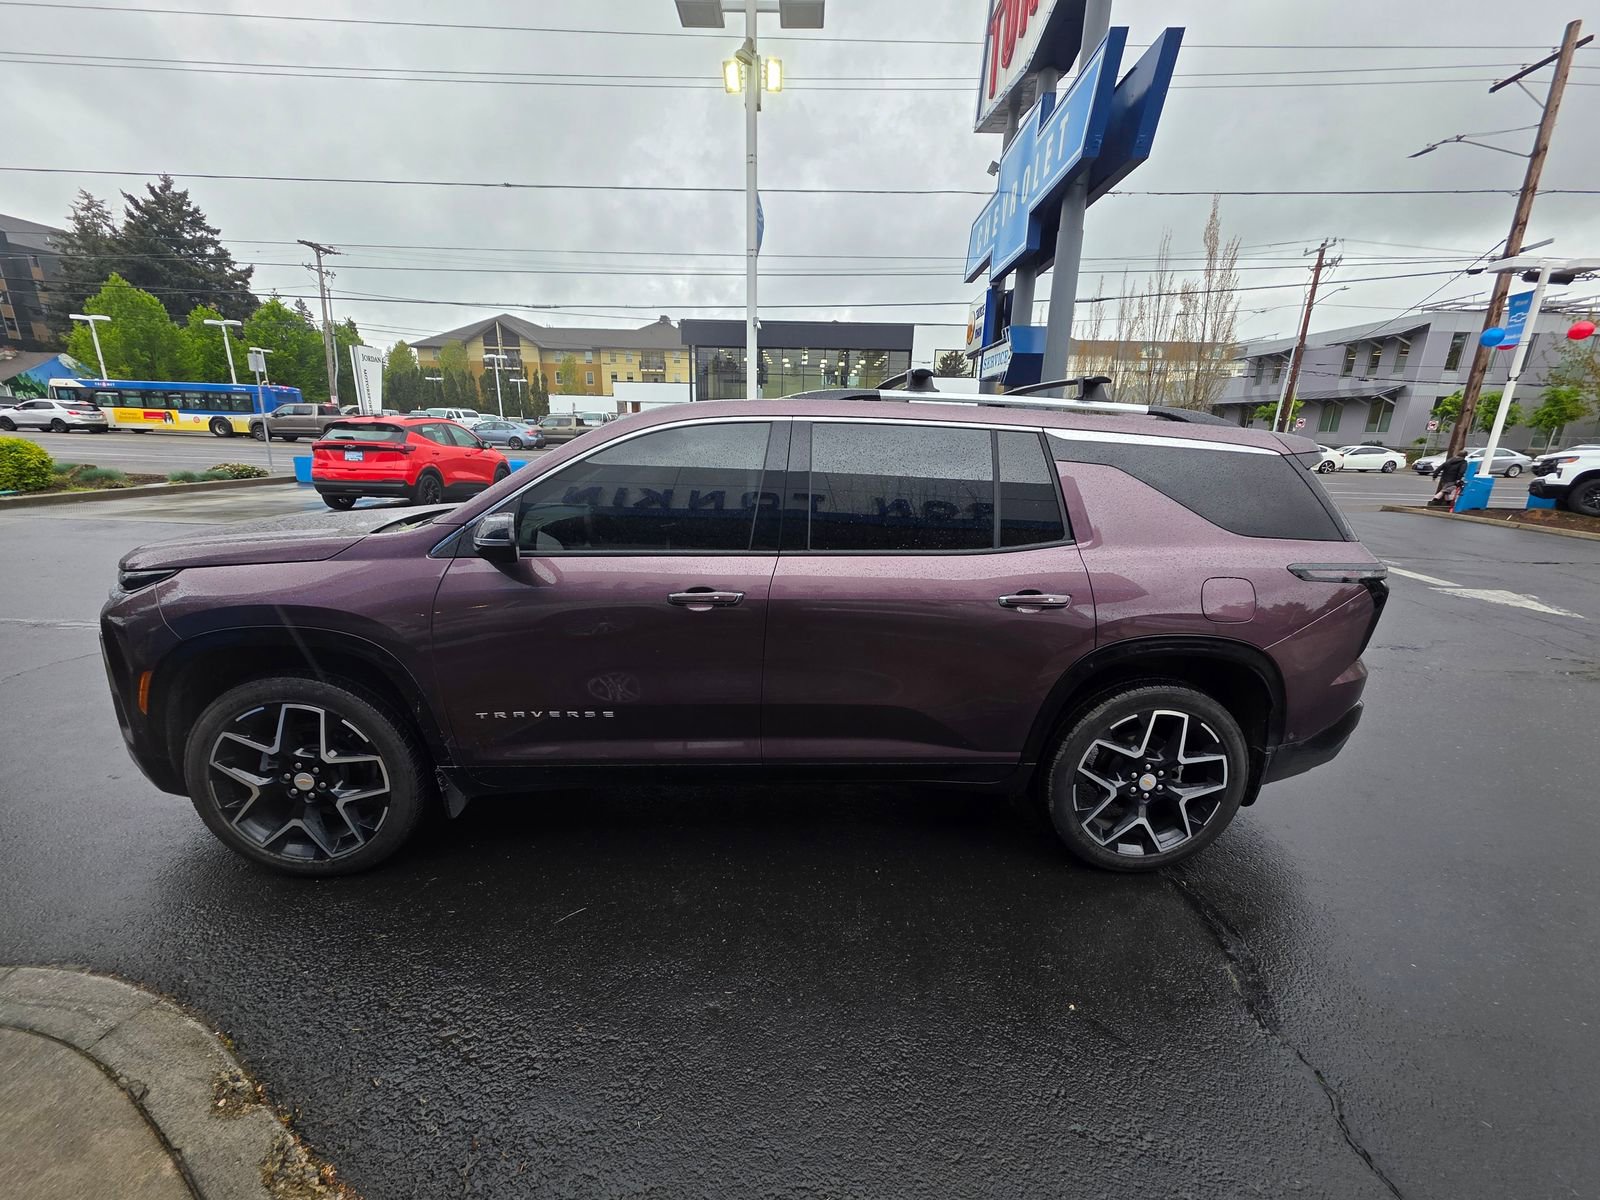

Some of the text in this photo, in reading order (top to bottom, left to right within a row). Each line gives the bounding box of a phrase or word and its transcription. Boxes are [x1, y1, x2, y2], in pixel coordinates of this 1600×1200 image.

[976, 111, 1070, 255] CHEVROLET
[361, 353, 381, 363] JORDAN
[983, 349, 1008, 370] SERVICE
[475, 710, 615, 719] TRAVERSE
